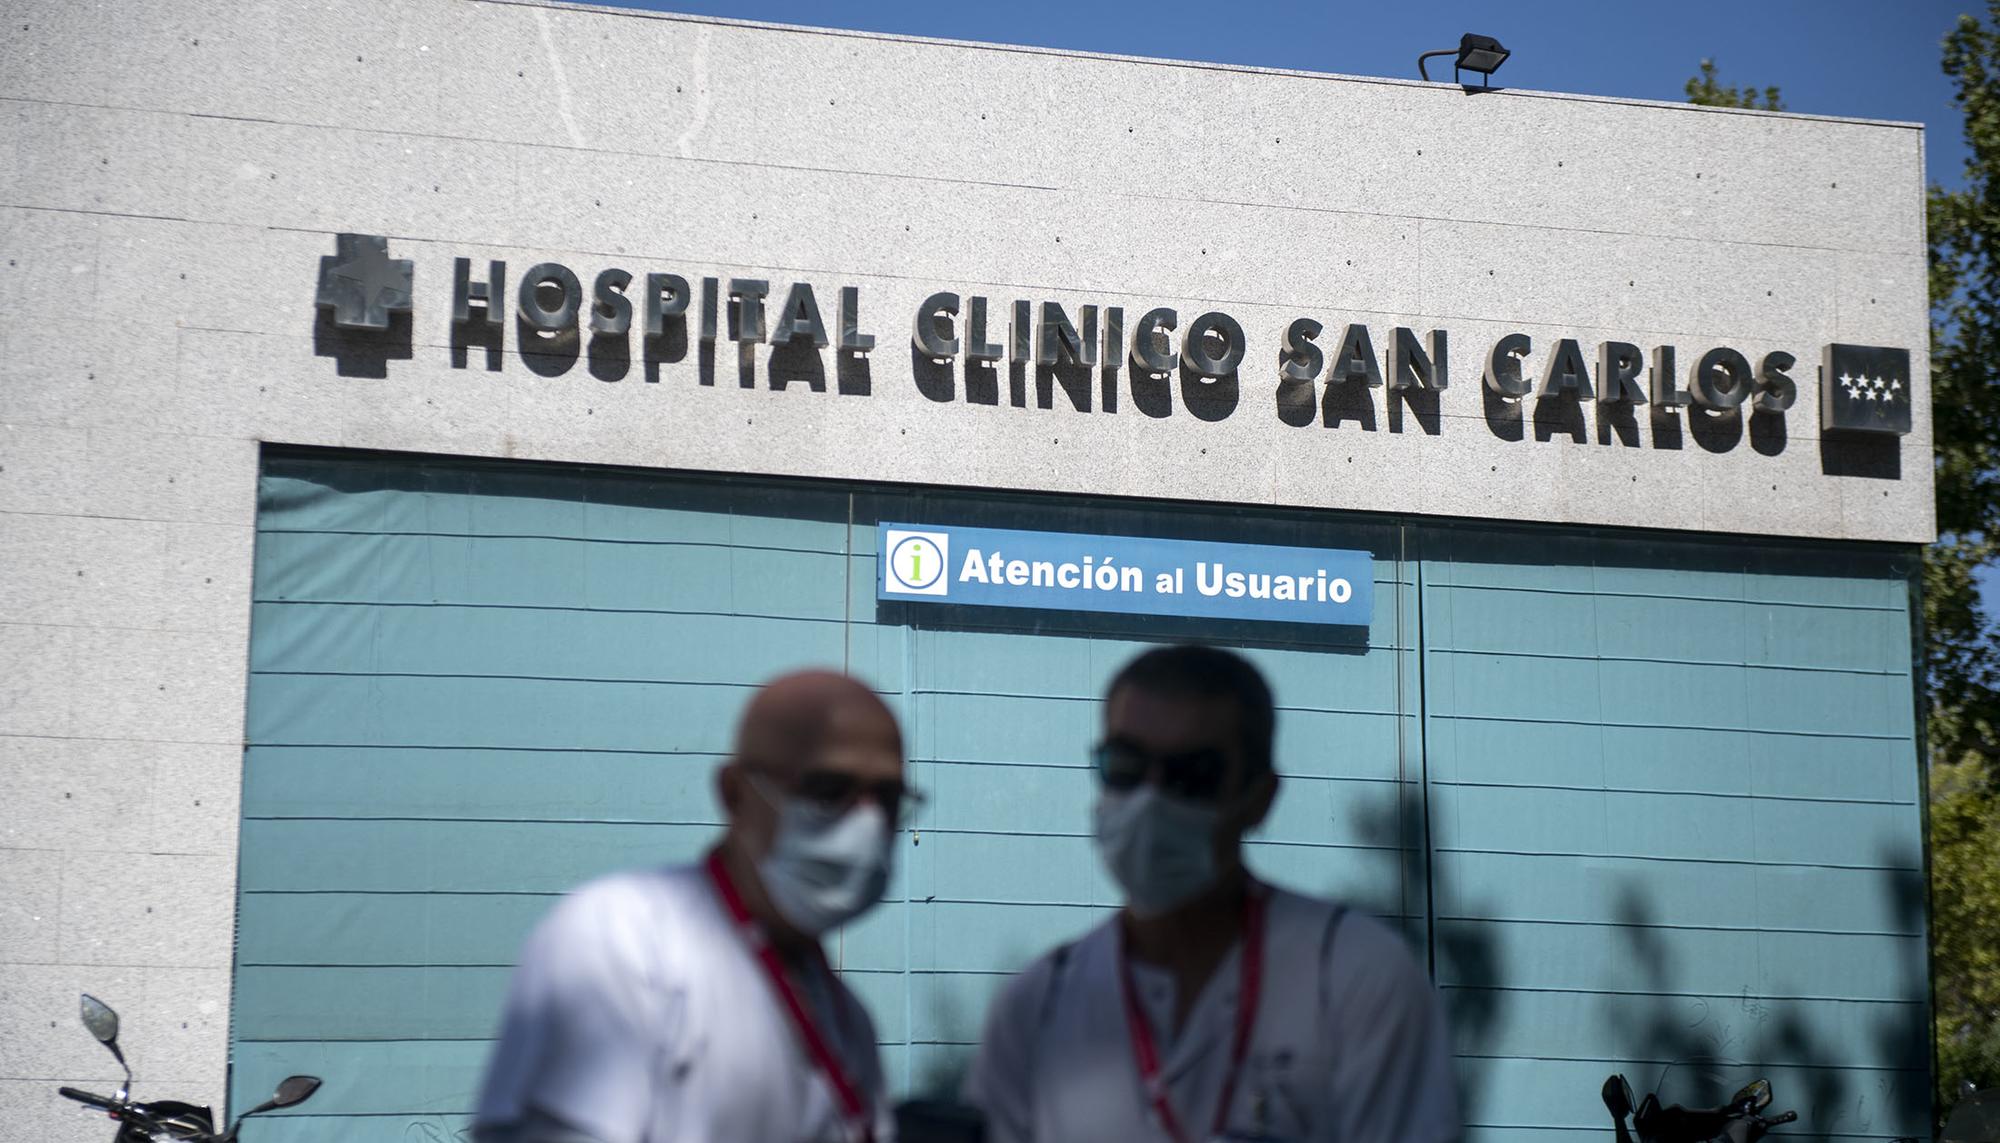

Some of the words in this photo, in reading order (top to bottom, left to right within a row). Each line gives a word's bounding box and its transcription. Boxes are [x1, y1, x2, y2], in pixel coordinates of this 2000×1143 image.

[452, 257, 876, 349] HOSPITAL
[913, 291, 1246, 377] CLINICO
[1278, 317, 1449, 391] SAN
[1484, 332, 1797, 412] CARLOS
[958, 548, 1144, 592] Atención
[1155, 567, 1184, 594] al
[1195, 562, 1353, 604] Usuario
